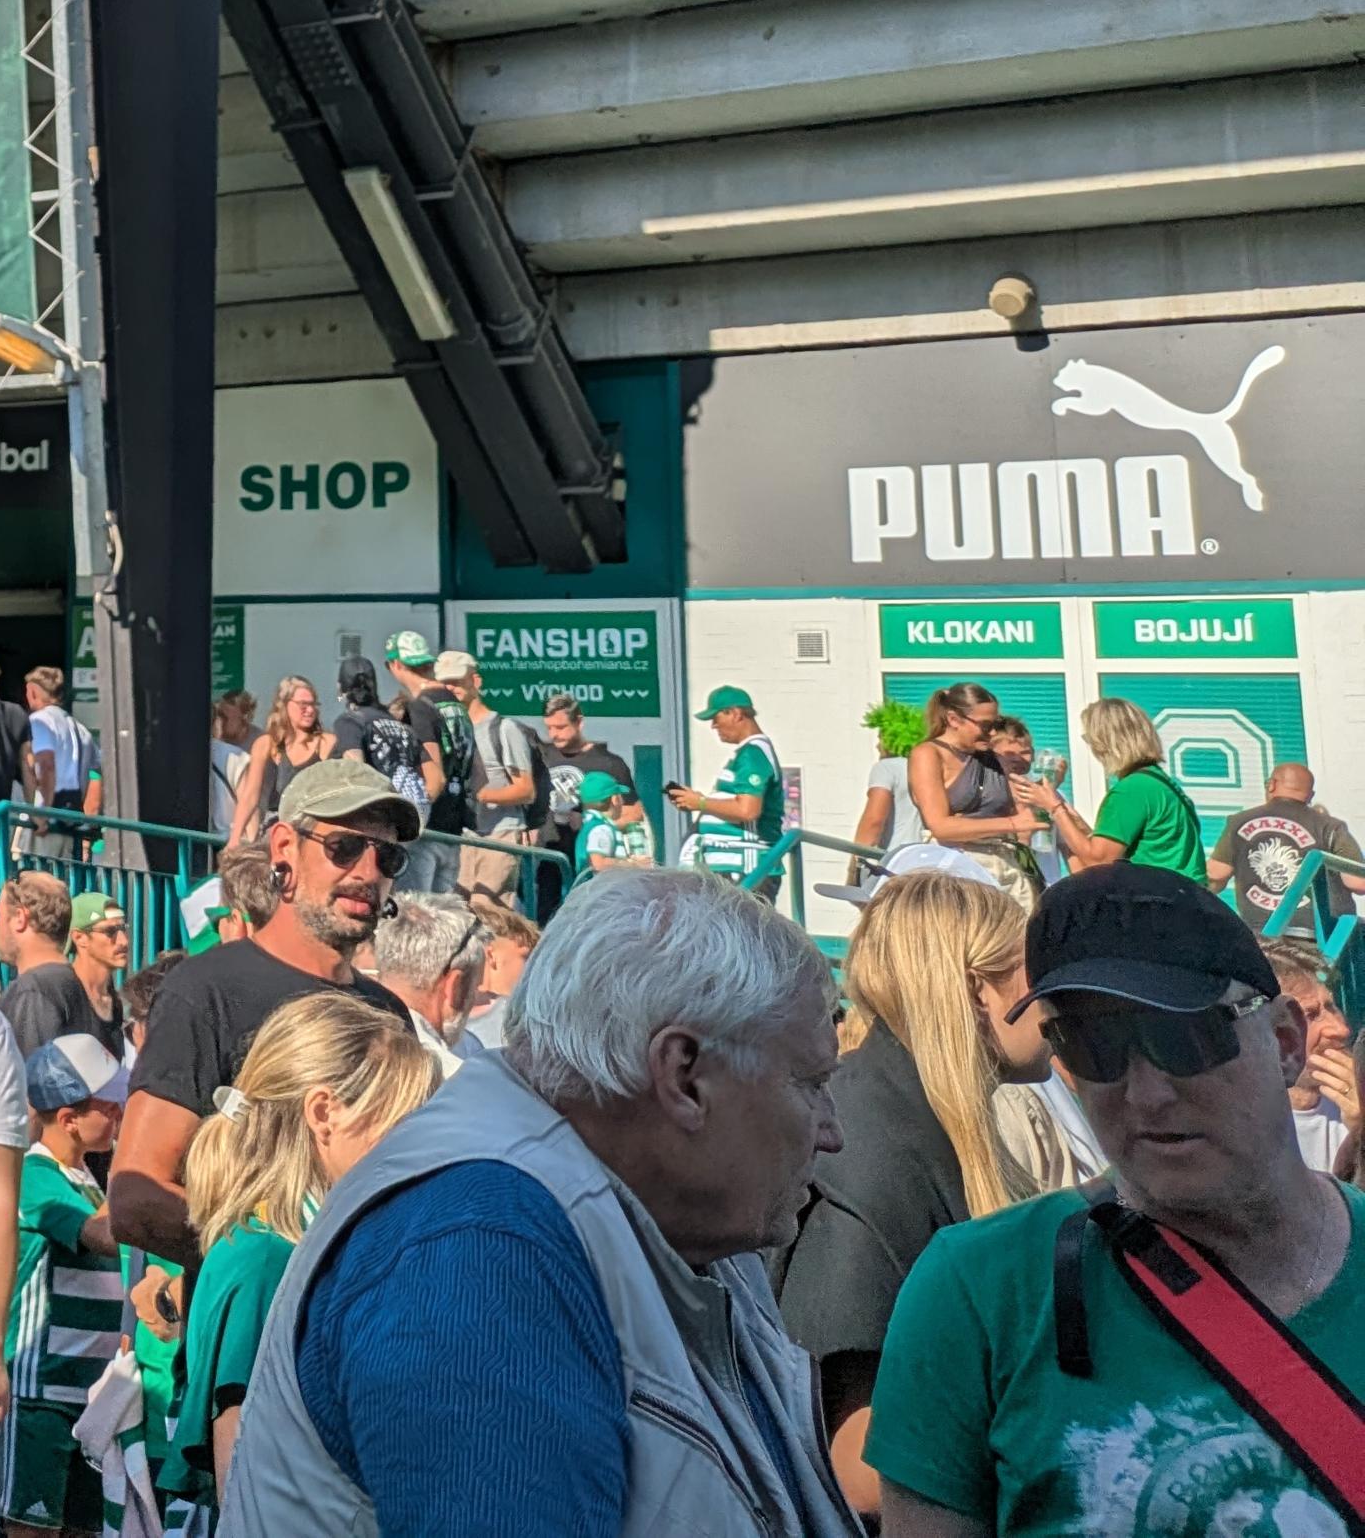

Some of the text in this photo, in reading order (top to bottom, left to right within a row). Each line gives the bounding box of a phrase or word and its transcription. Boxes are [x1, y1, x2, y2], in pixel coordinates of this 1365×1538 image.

[239, 461, 411, 512] SHOP
[847, 453, 1197, 563] PUMA
[76, 625, 97, 660] A
[213, 623, 237, 638] AN
[475, 627, 649, 659] FANSHOP
[907, 619, 1036, 645] KLOKANI
[1133, 613, 1255, 643] BOJUJÍ
[477, 658, 650, 672] www.fanshopbohemians.cz
[1240, 818, 1311, 847] MAXXL
